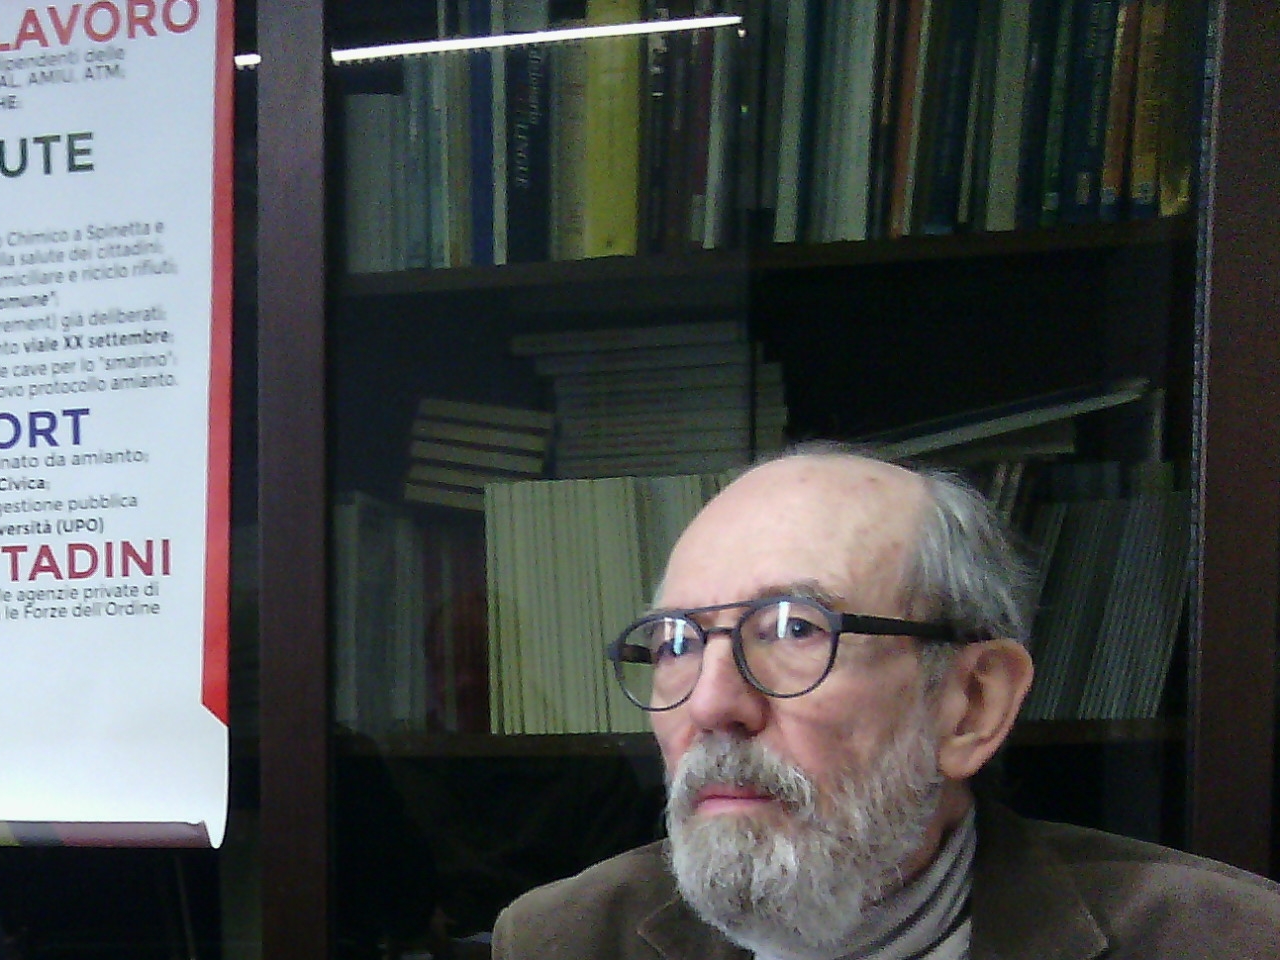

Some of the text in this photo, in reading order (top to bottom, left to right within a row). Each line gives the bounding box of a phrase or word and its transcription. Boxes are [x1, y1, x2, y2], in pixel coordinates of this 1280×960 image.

[84, 47, 126, 64] delle
[6, 229, 68, 247] Chimico
[74, 230, 82, 241] a
[86, 221, 150, 243] Spinetta
[154, 223, 164, 234] e
[20, 248, 64, 265] salute
[68, 245, 92, 261] dei
[68, 272, 78, 283] e
[80, 265, 128, 282] riciclo
[22, 337, 58, 353] viale
[62, 335, 84, 350] XX
[12, 364, 48, 377] cave
[52, 362, 76, 378] per
[80, 357, 94, 372] lo
[28, 377, 106, 399] protocollo
[44, 453, 66, 468] da
[70, 494, 138, 514] pubblica
[56, 517, 104, 538] (UPO)
[16, 585, 78, 605] agenzie
[82, 583, 140, 603] private
[144, 582, 160, 597] di
[6, 605, 18, 619] le
[24, 604, 68, 619] Forze
[72, 600, 160, 617] dell'Ordine
